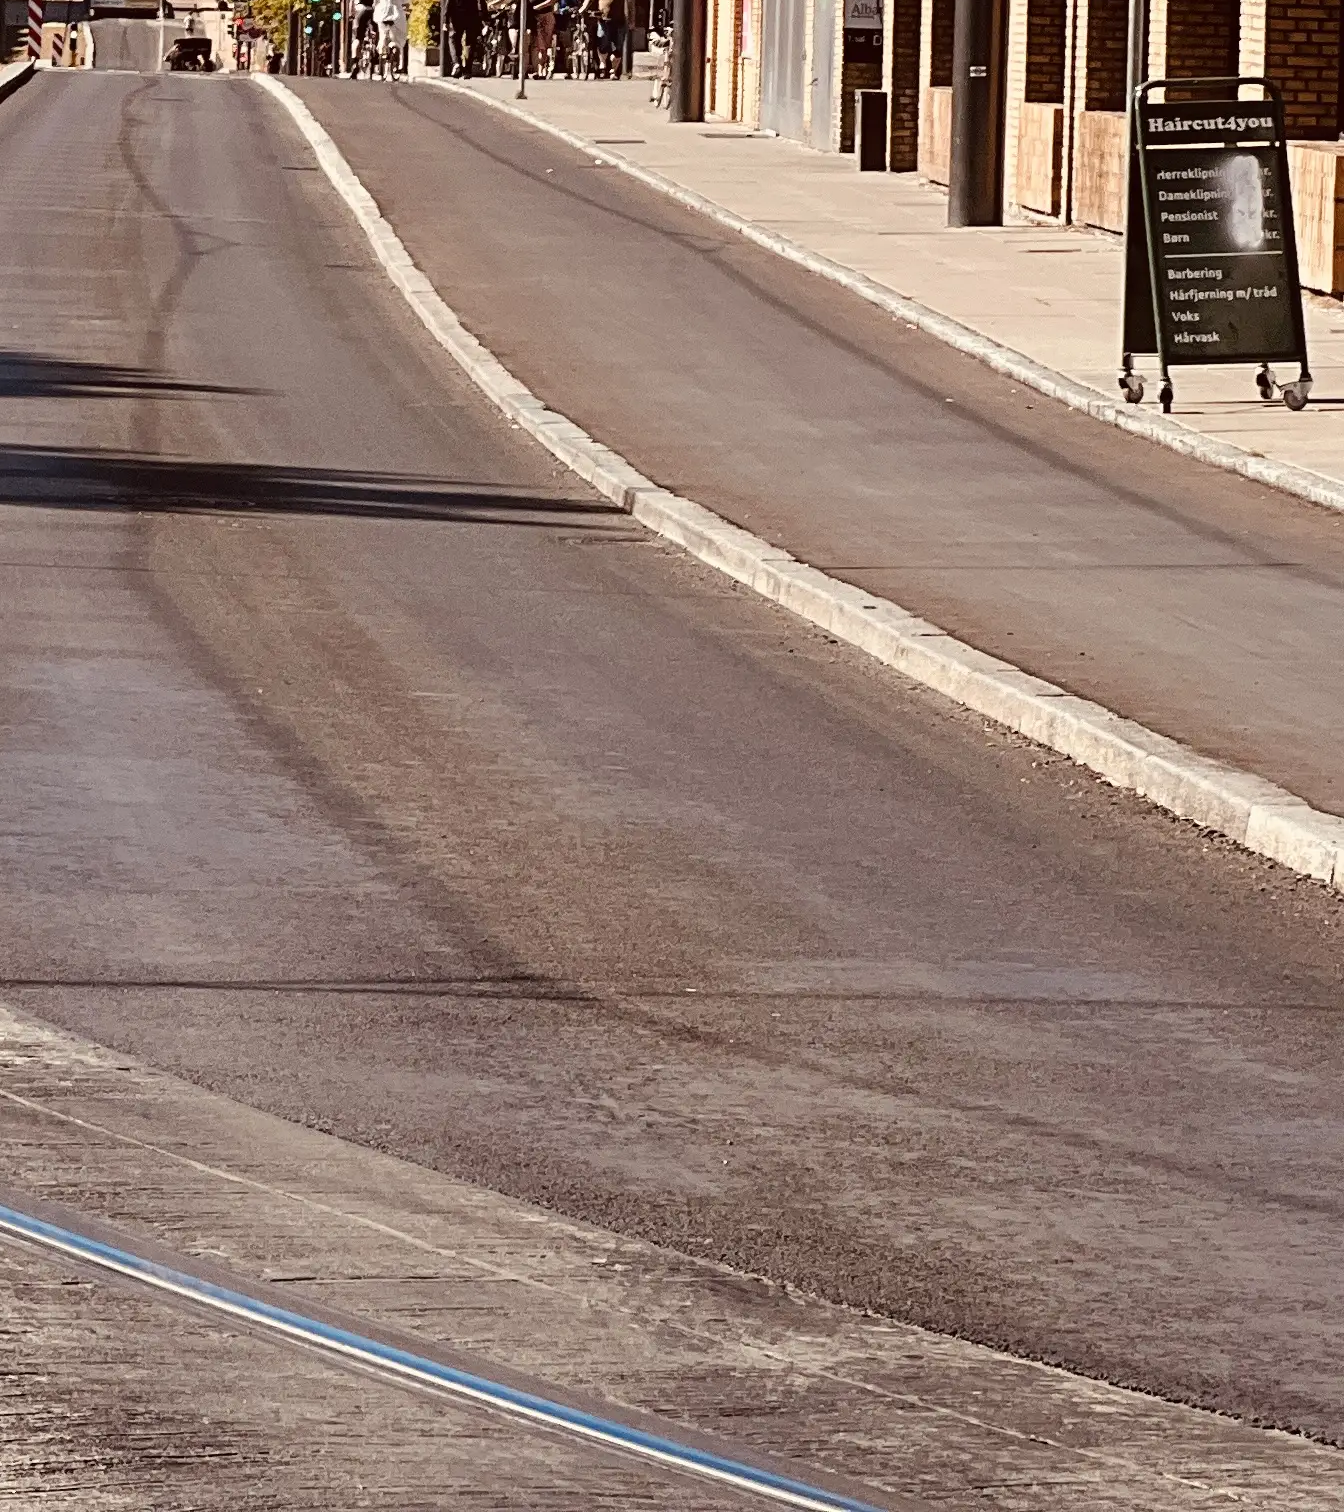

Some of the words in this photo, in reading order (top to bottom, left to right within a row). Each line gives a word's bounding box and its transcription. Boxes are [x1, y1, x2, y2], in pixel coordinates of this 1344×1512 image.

[1147, 116, 1274, 133] Haircut4you
[1160, 210, 1219, 223] Pensionist
[1162, 232, 1190, 244] Børn
[1167, 267, 1223, 280] Barbering
[1169, 288, 1234, 302] Hårfjerning
[1235, 287, 1252, 300] m/
[1253, 285, 1278, 298] tråd
[1171, 310, 1200, 323] Voks
[1173, 330, 1221, 344] Hårvask
